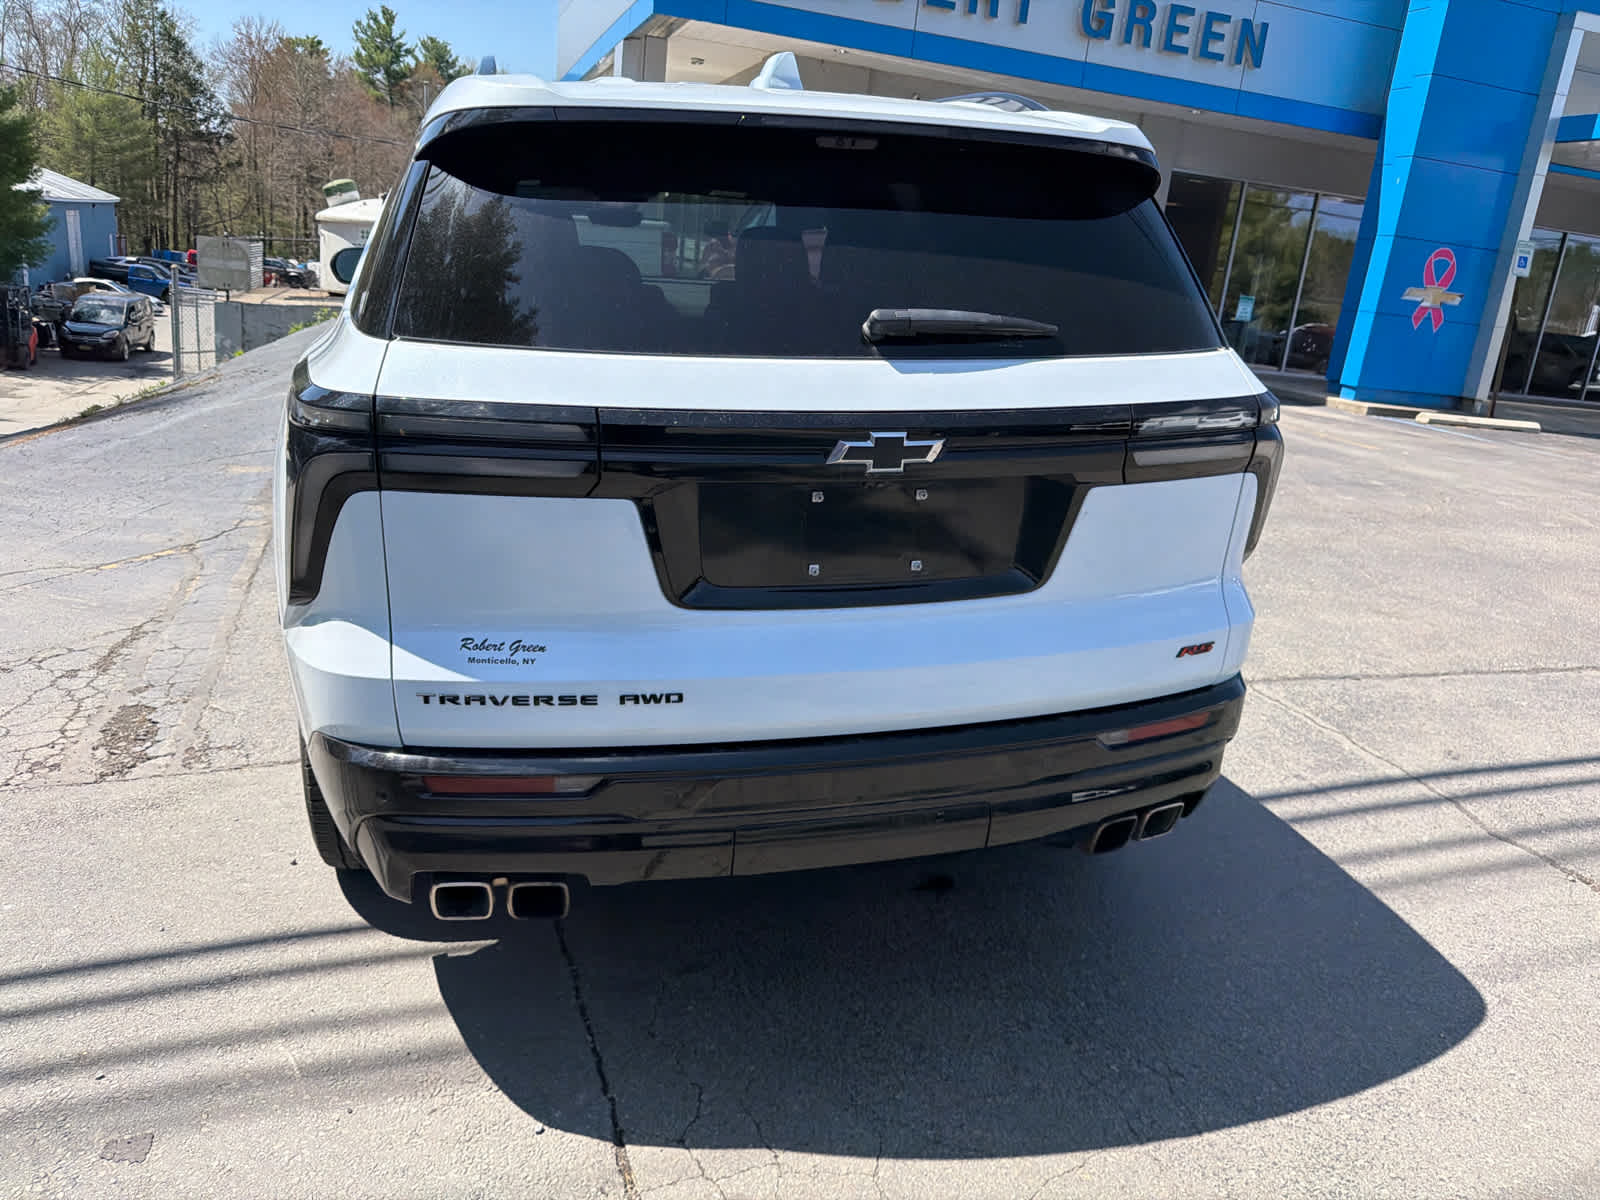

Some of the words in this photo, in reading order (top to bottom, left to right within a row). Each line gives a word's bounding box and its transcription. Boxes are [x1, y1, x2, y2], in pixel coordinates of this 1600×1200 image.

[1081, 0, 1270, 69] GREEN
[459, 637, 506, 652] Robert
[509, 639, 547, 657] Green
[467, 656, 520, 667] Monticello,
[522, 657, 537, 665] NY
[416, 692, 599, 706] TRAVERSE
[619, 692, 684, 705] AWD
